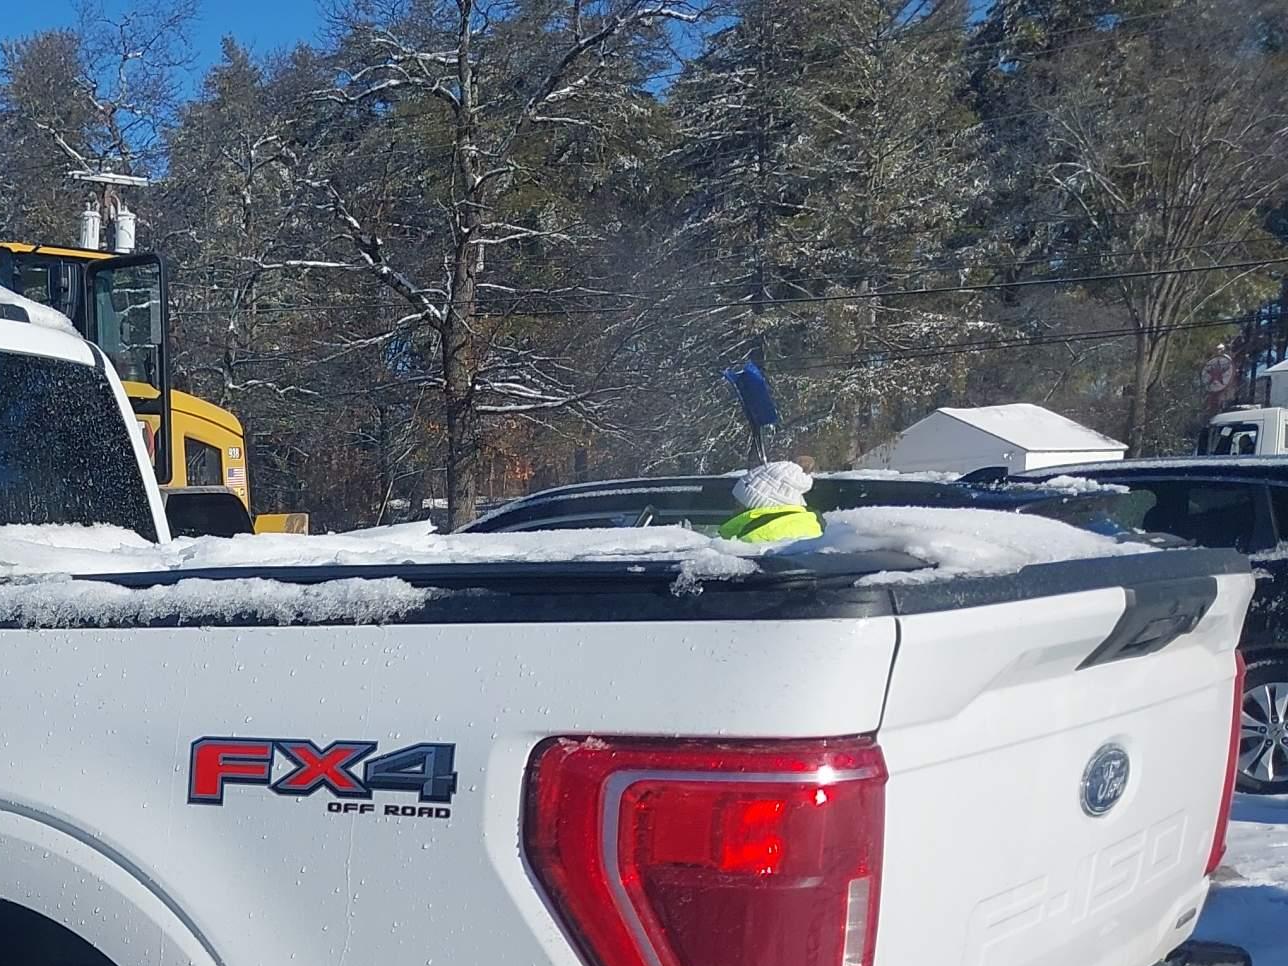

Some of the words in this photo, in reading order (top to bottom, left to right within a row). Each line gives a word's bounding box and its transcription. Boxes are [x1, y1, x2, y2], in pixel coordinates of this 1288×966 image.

[187, 736, 458, 806] FX4
[327, 802, 375, 814] OFF
[384, 805, 451, 819] ROAD
